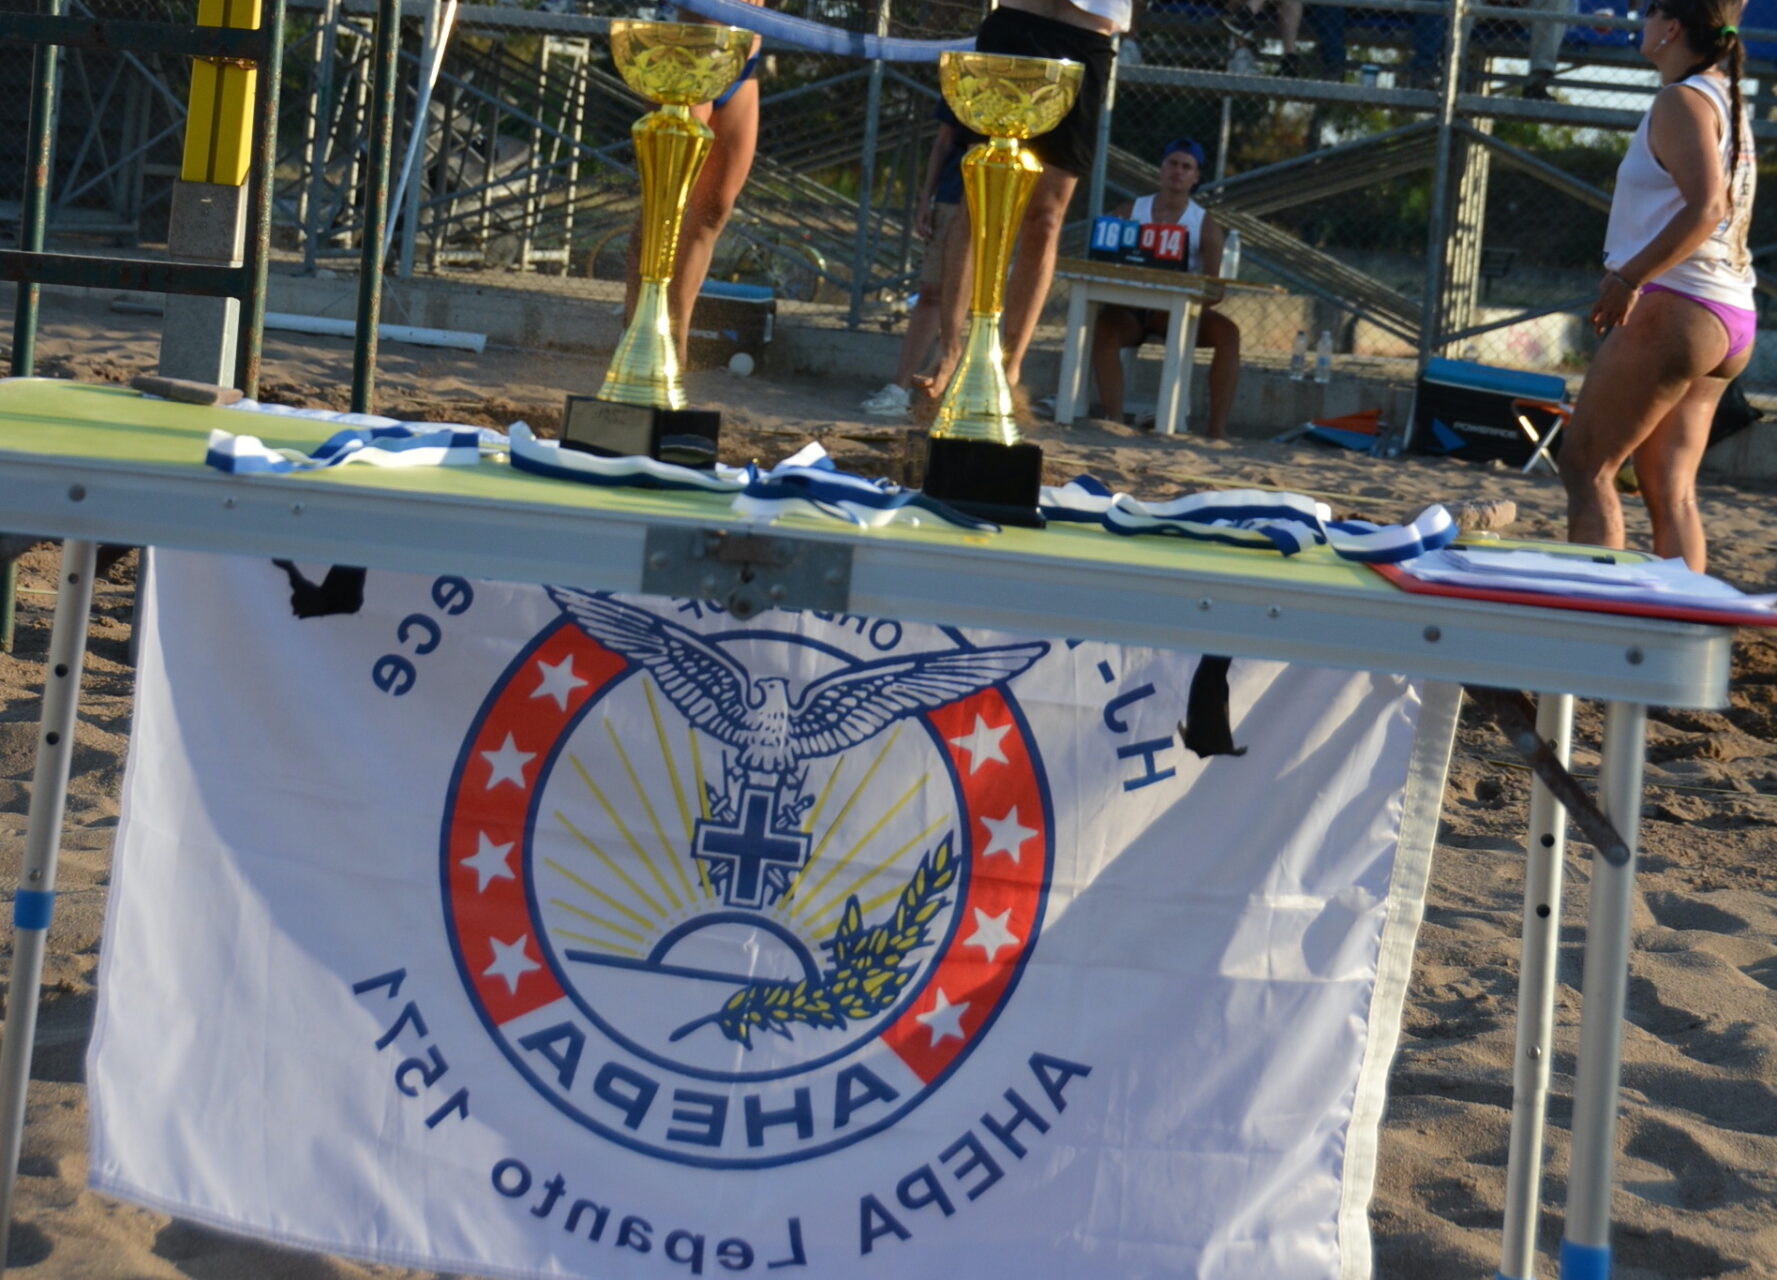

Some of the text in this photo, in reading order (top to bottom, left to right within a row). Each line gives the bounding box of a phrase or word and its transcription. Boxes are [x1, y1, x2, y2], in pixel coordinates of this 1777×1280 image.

[1097, 221, 1182, 256] 16 0 0 14
